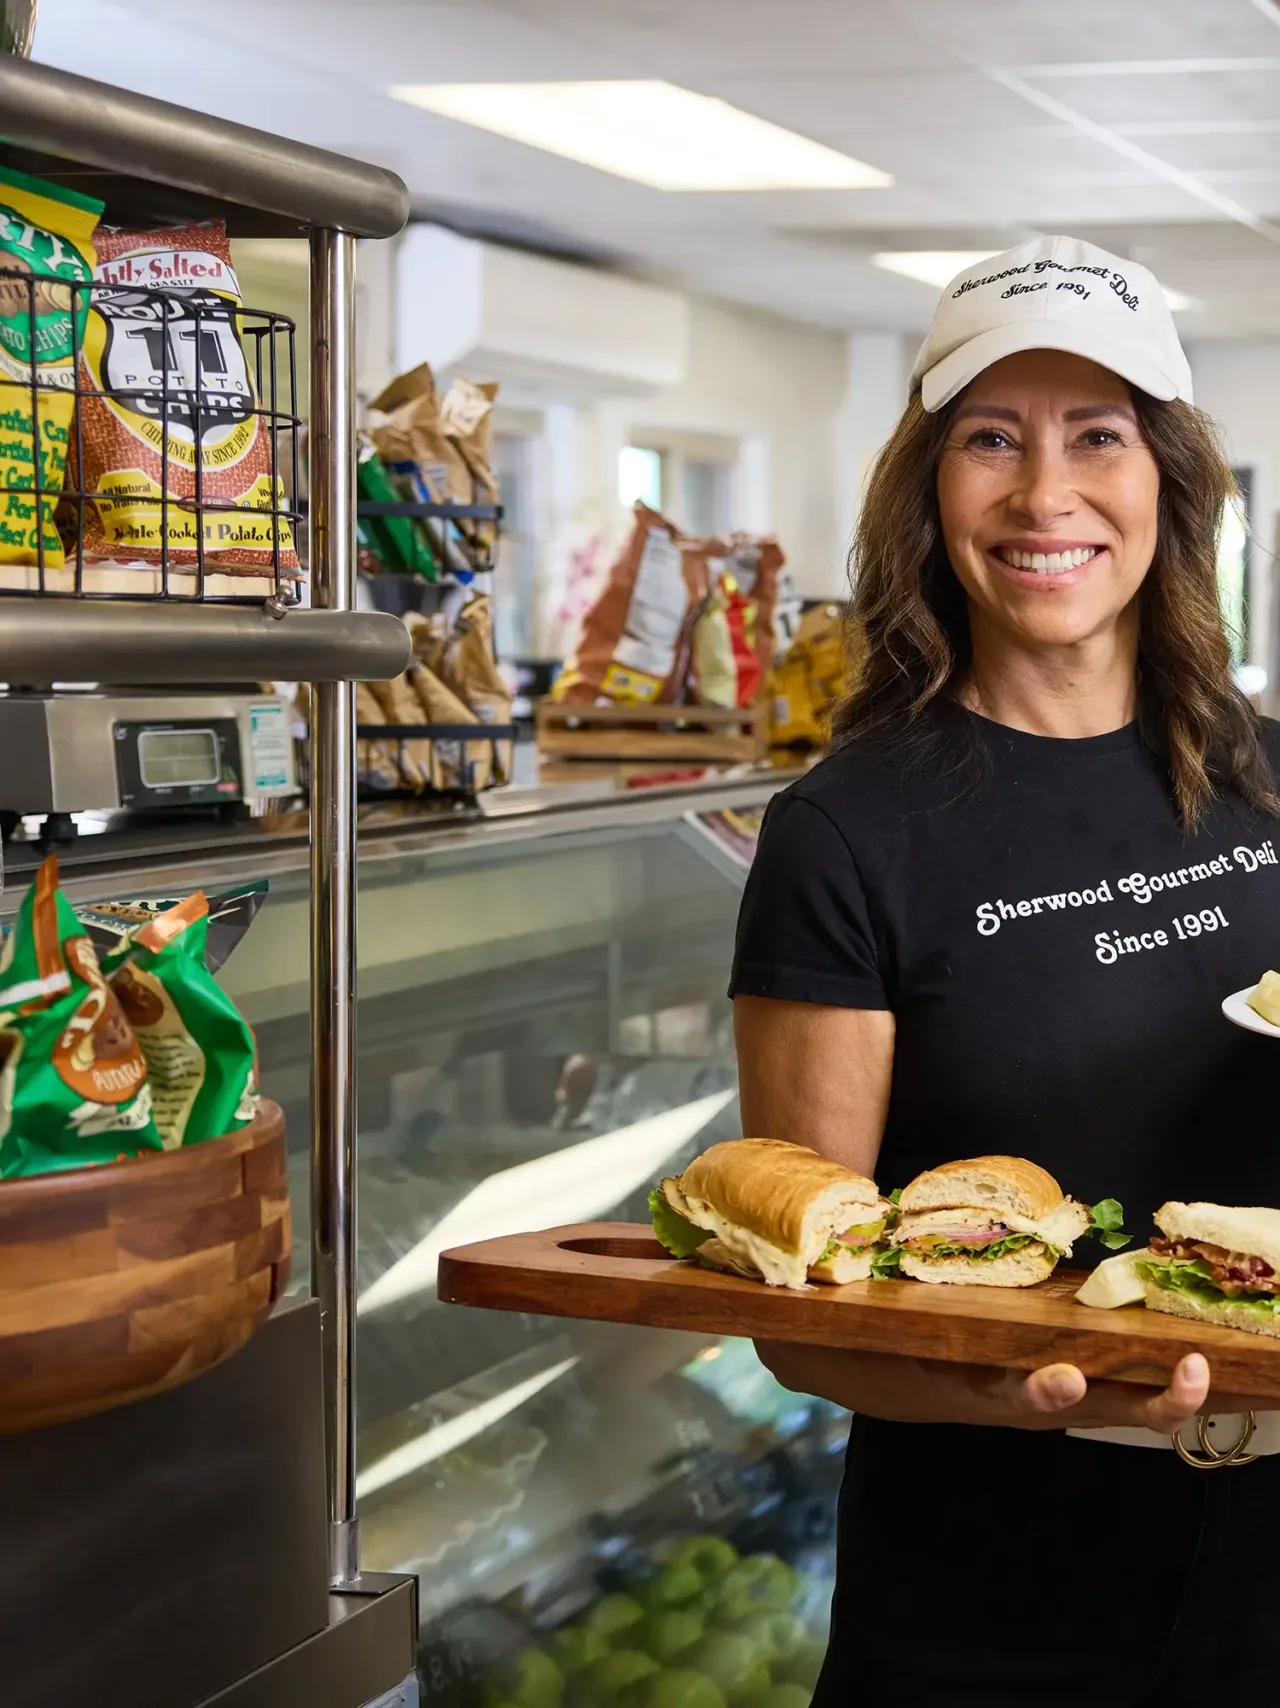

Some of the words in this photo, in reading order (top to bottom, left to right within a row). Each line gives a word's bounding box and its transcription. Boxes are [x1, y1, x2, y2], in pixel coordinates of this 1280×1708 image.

[93, 260, 144, 284] htly
[149, 254, 222, 280] Salted
[952, 263, 1030, 299] Sherwood
[1034, 259, 1111, 279] Gourmet
[1109, 273, 1139, 312] Deli
[1000, 281, 1047, 299] Since
[1056, 282, 1092, 301] 1991
[125, 326, 228, 374] 11
[213, 441, 238, 464] SINCE
[235, 426, 250, 450] 1992
[114, 483, 151, 495] Natural
[100, 503, 112, 513] No
[217, 523, 264, 542] Potato
[265, 527, 292, 544] Cips
[976, 880, 1114, 936] Sherwood
[1117, 853, 1234, 904] Gourmet
[1232, 839, 1279, 873] Deli
[1094, 928, 1169, 965] Since
[1172, 905, 1230, 941] 1991
